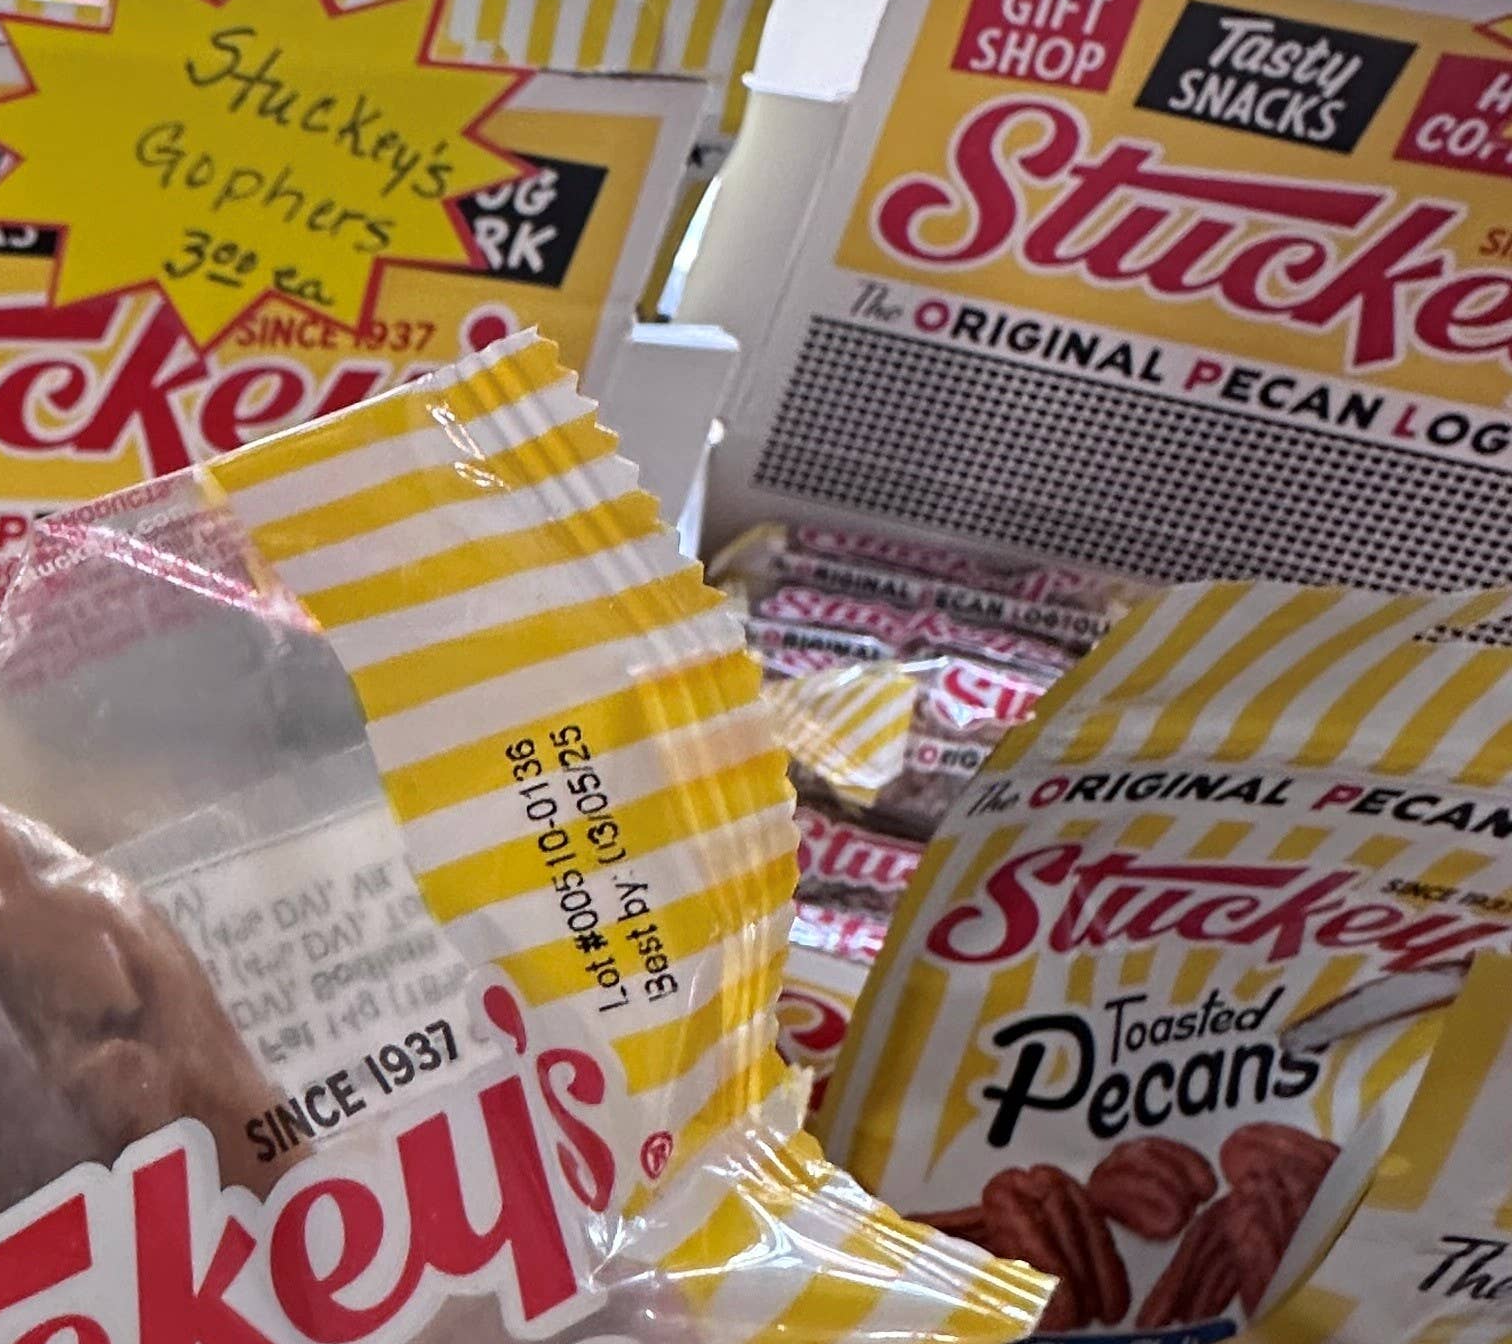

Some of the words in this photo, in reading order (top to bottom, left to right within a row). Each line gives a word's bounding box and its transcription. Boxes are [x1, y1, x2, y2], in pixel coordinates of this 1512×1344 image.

[974, 28, 1106, 83] SHOP
[1200, 14, 1364, 96] Tasty
[184, 26, 454, 199] Stuckey's
[1168, 68, 1346, 144] SNACKS
[135, 120, 396, 253] Gophers
[872, 96, 1512, 370] Stucke
[238, 313, 337, 349] SINCE
[848, 284, 902, 324] The
[913, 299, 1164, 384] ORIGINAL
[1183, 361, 1382, 430] PECAN
[968, 780, 1020, 816] The
[1028, 772, 1294, 810] ORIGINAL
[1311, 782, 1512, 838] PECAN
[926, 844, 1510, 972] Stuckey
[584, 956, 630, 1012] Lot
[626, 923, 678, 1002] Best
[1105, 986, 1286, 1064] Toasted
[245, 1069, 367, 1162] SINCE
[364, 1019, 457, 1095] 1937
[984, 1014, 1326, 1148] Pecans
